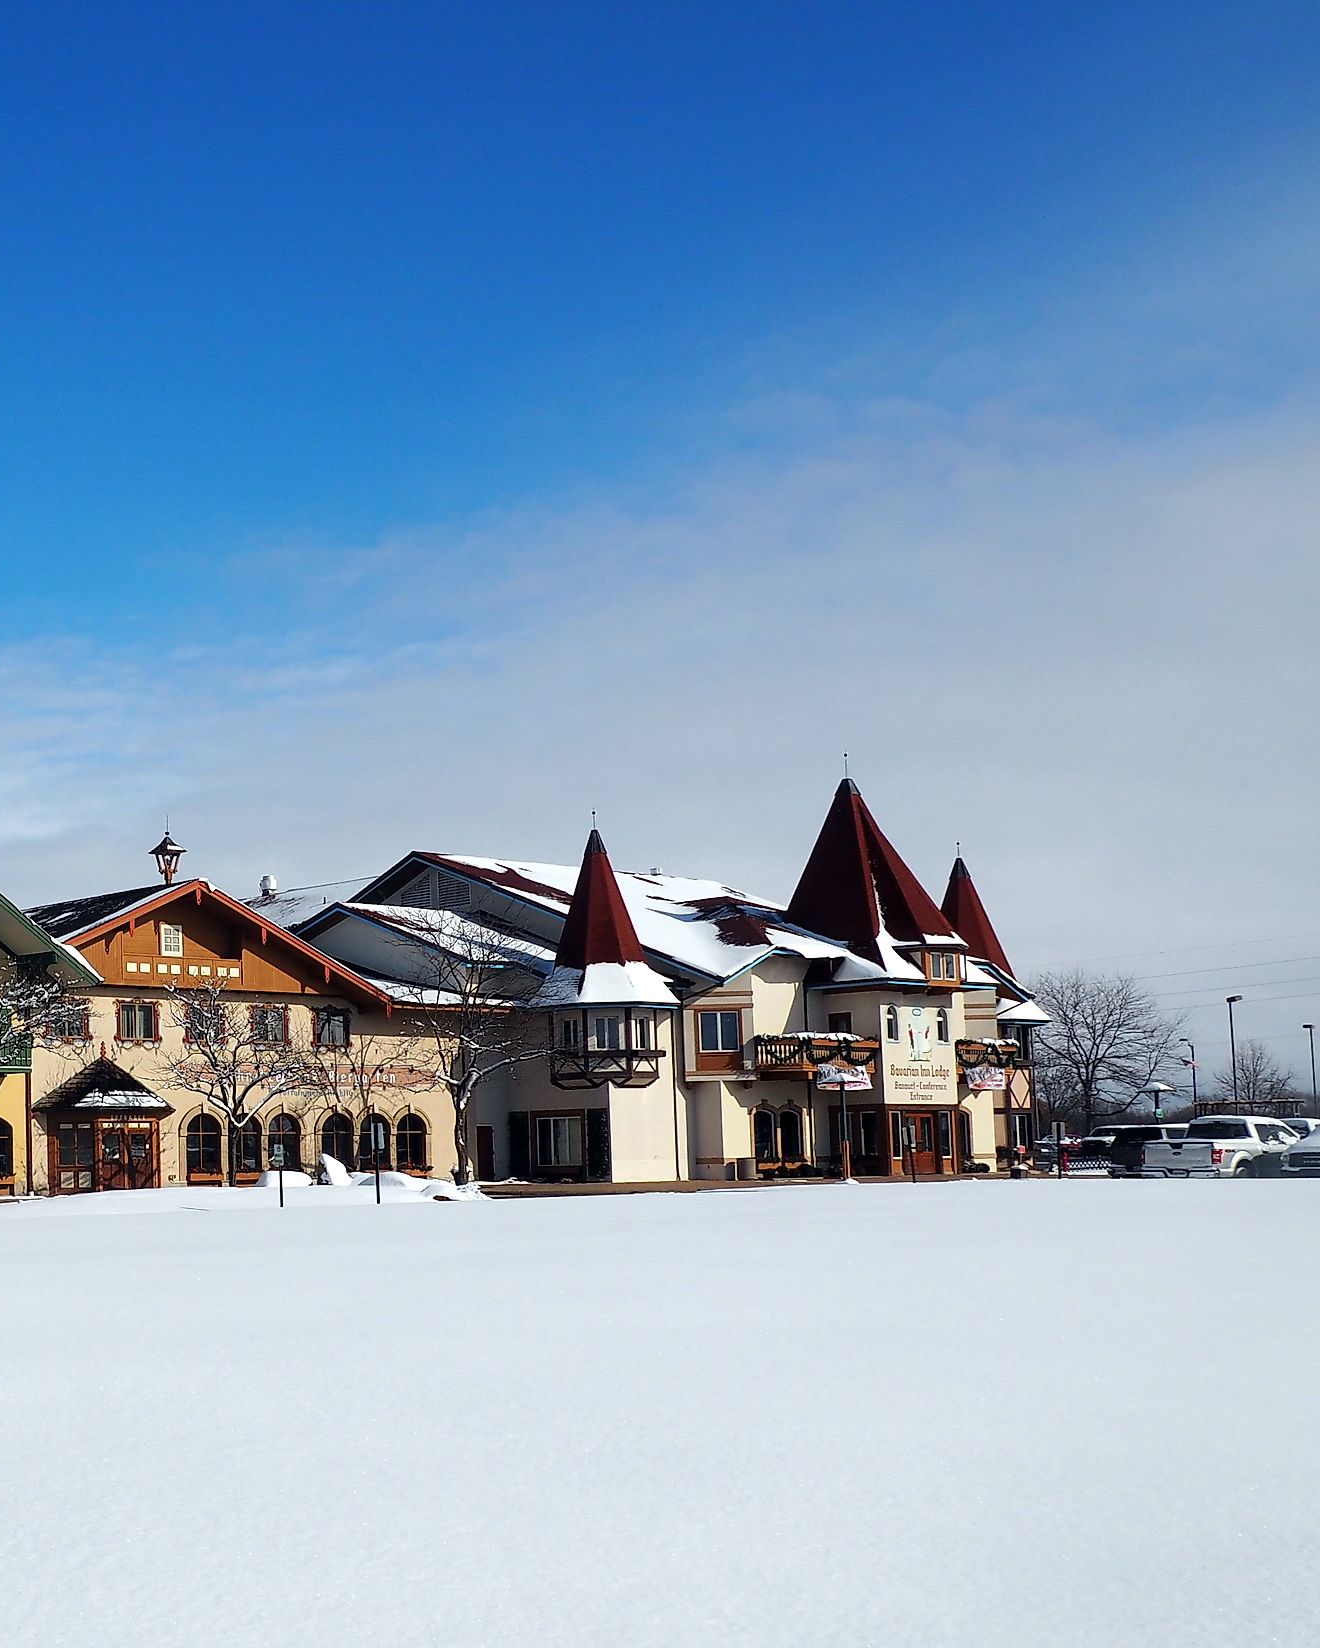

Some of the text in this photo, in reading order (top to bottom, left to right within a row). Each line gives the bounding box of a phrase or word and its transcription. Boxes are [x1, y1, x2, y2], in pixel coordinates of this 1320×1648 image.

[890, 1064, 919, 1077] Bavarian
[920, 1065, 930, 1077] Inn
[931, 1064, 950, 1080] Lodge
[910, 1092, 933, 1100] Entrance
